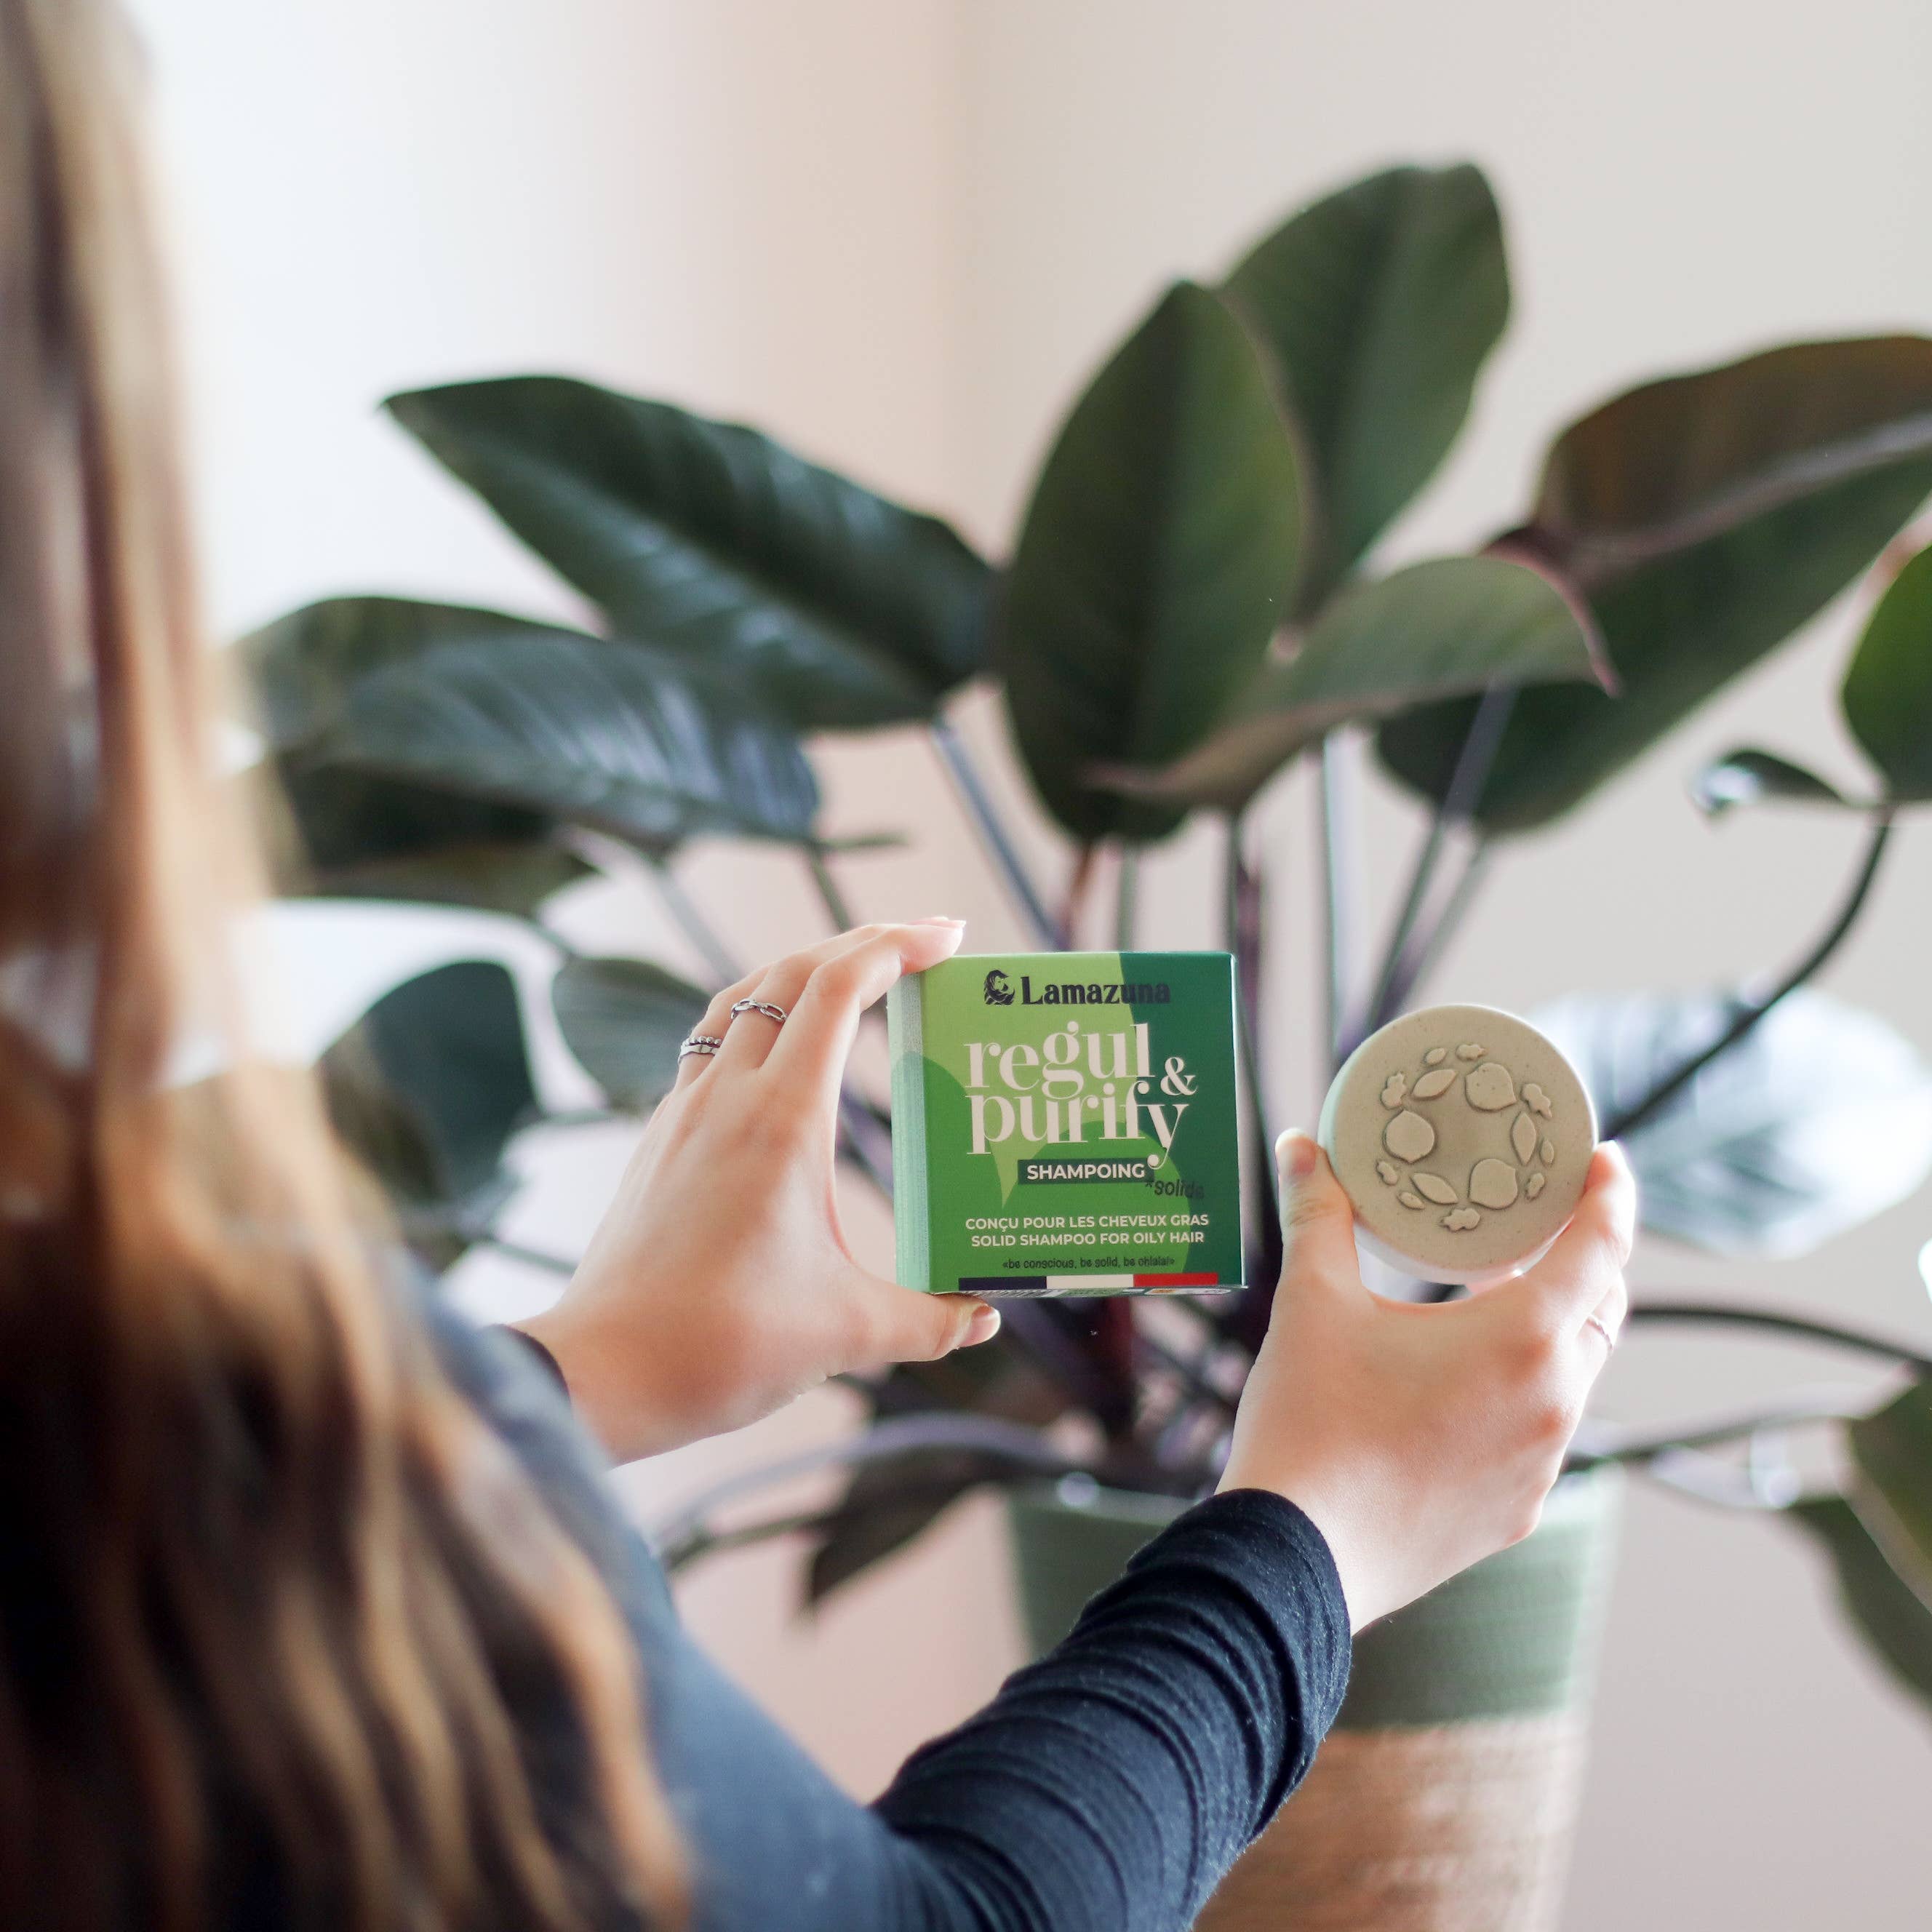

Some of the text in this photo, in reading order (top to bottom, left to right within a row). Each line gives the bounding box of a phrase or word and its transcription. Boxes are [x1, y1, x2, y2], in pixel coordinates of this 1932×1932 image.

[1020, 975, 1171, 1005] Lamazuna
[963, 1020, 1198, 1100] regul &
[965, 1079, 1190, 1170] purify
[1026, 1163, 1146, 1181] SHAMPOING
[965, 1214, 1210, 1232] CONÇU POUR LES CHEVEUX GRAS
[971, 1231, 1205, 1248] SOLID SHAMPOO FOR OILY HAIR
[1080, 1257, 1093, 1268] be
[1124, 1256, 1136, 1267] be
